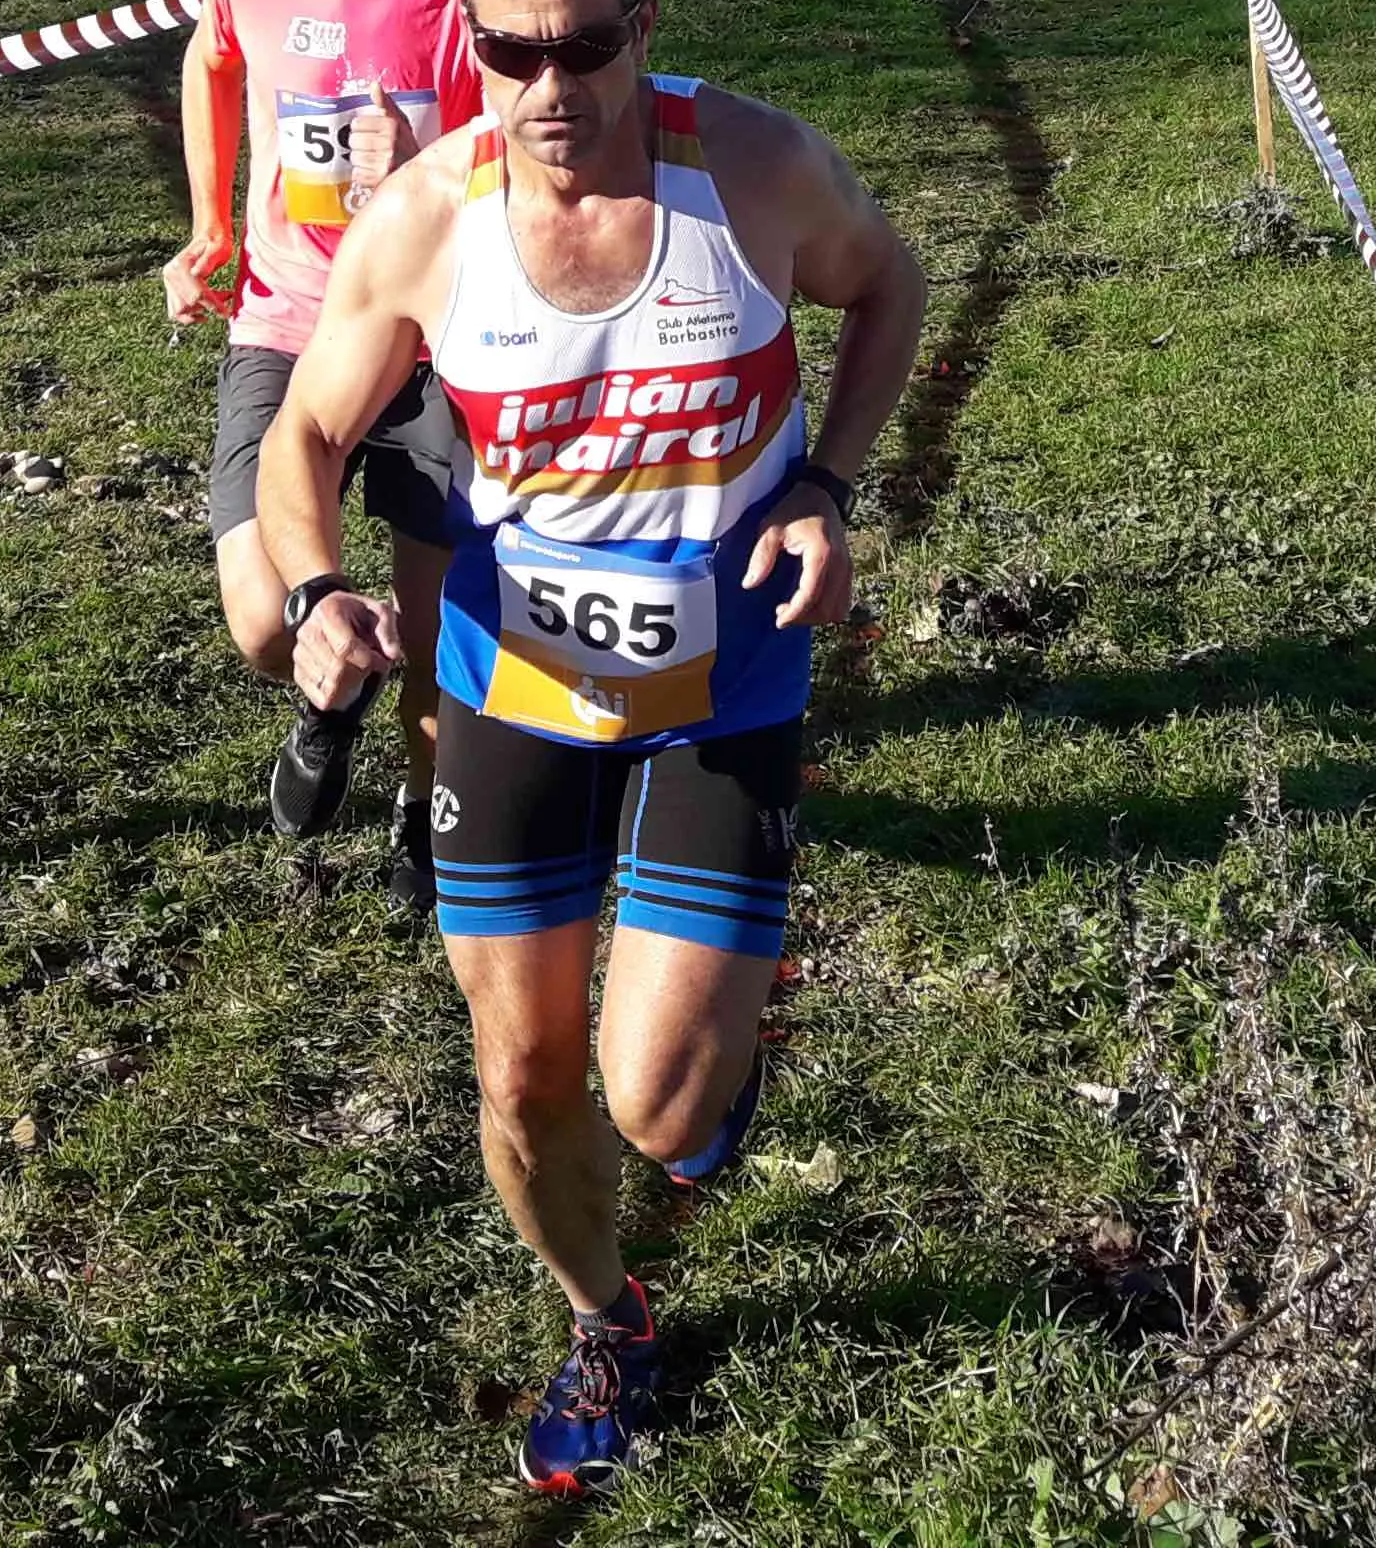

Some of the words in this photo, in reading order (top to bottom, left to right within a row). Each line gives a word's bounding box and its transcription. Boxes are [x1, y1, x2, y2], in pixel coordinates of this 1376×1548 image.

[498, 326, 538, 347] barri
[656, 315, 682, 330] Club
[658, 325, 739, 346] Barbastro
[496, 373, 739, 443] julián
[485, 392, 761, 476] mairal
[527, 576, 678, 658] 565
